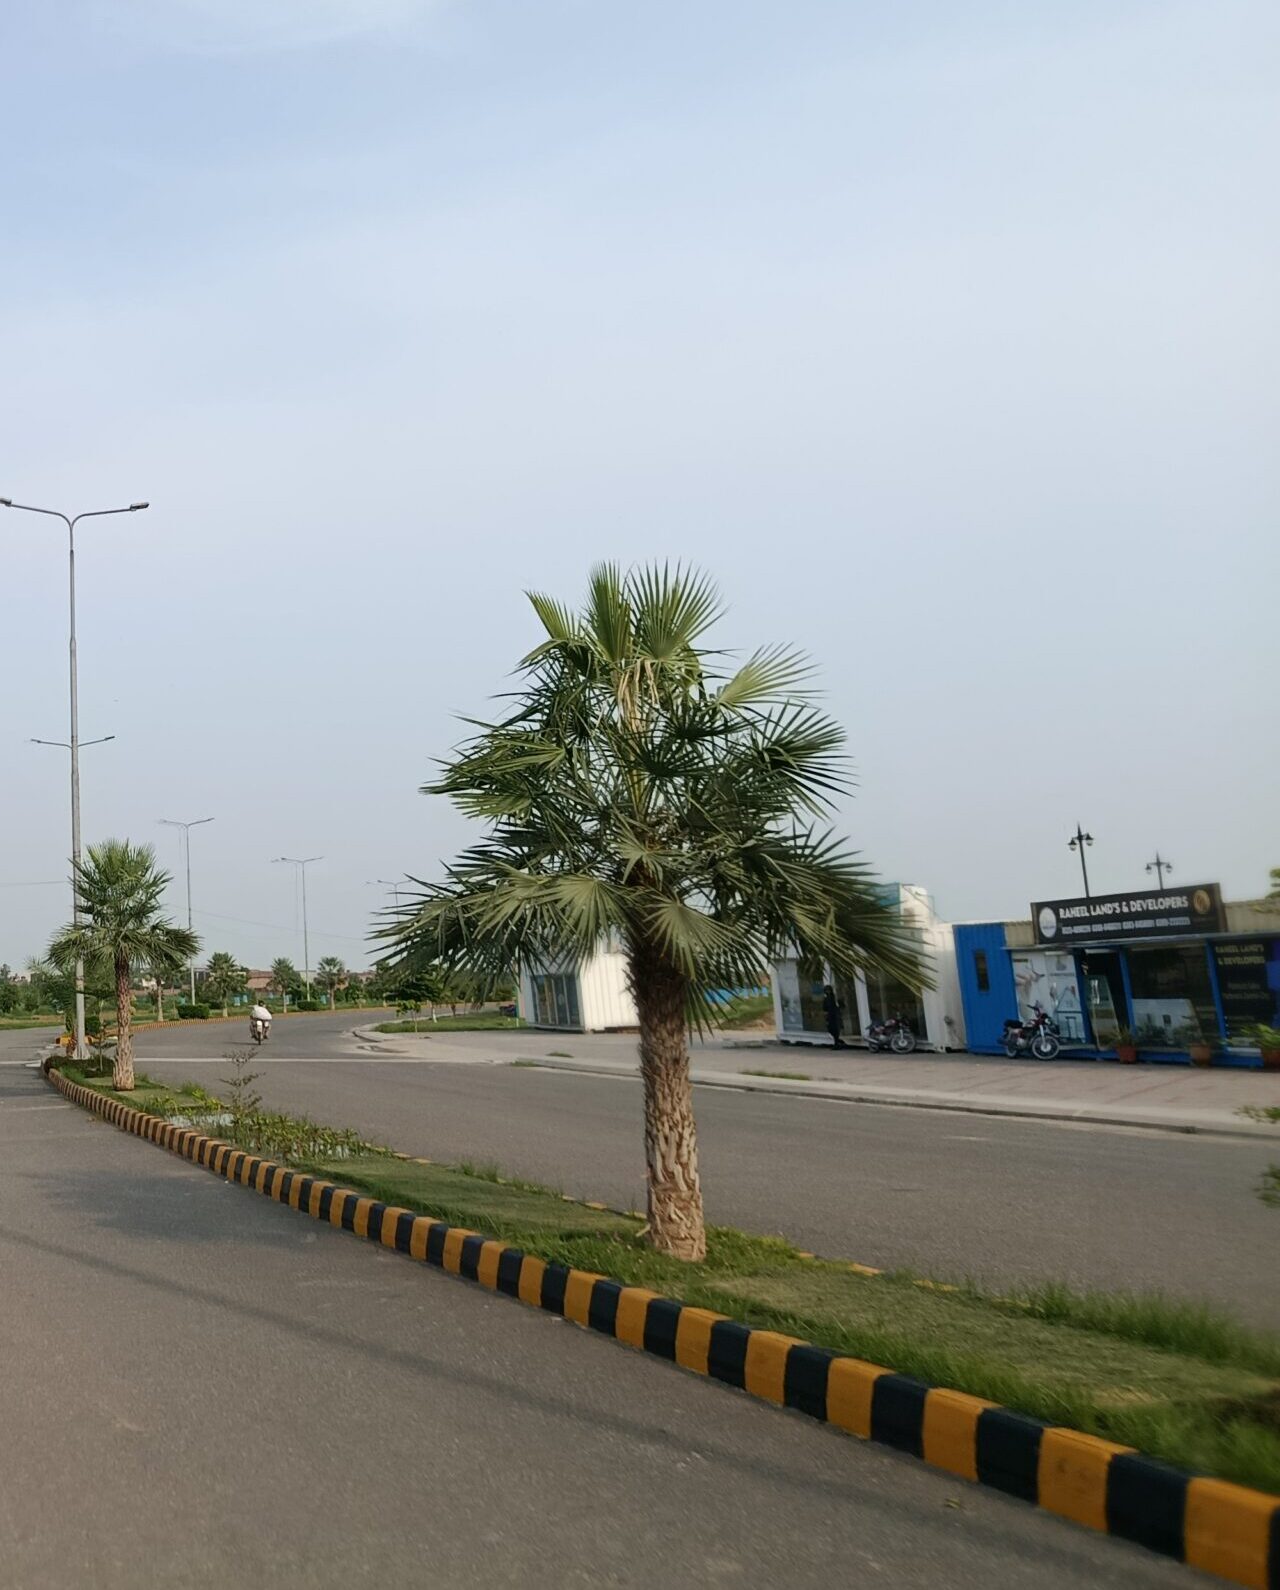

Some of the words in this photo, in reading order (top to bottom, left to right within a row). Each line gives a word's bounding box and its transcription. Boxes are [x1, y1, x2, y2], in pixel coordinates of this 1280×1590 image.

[1059, 906, 1090, 919] RAHEEL
[1121, 901, 1130, 913] &
[1130, 896, 1189, 912] DEVELOPERS
